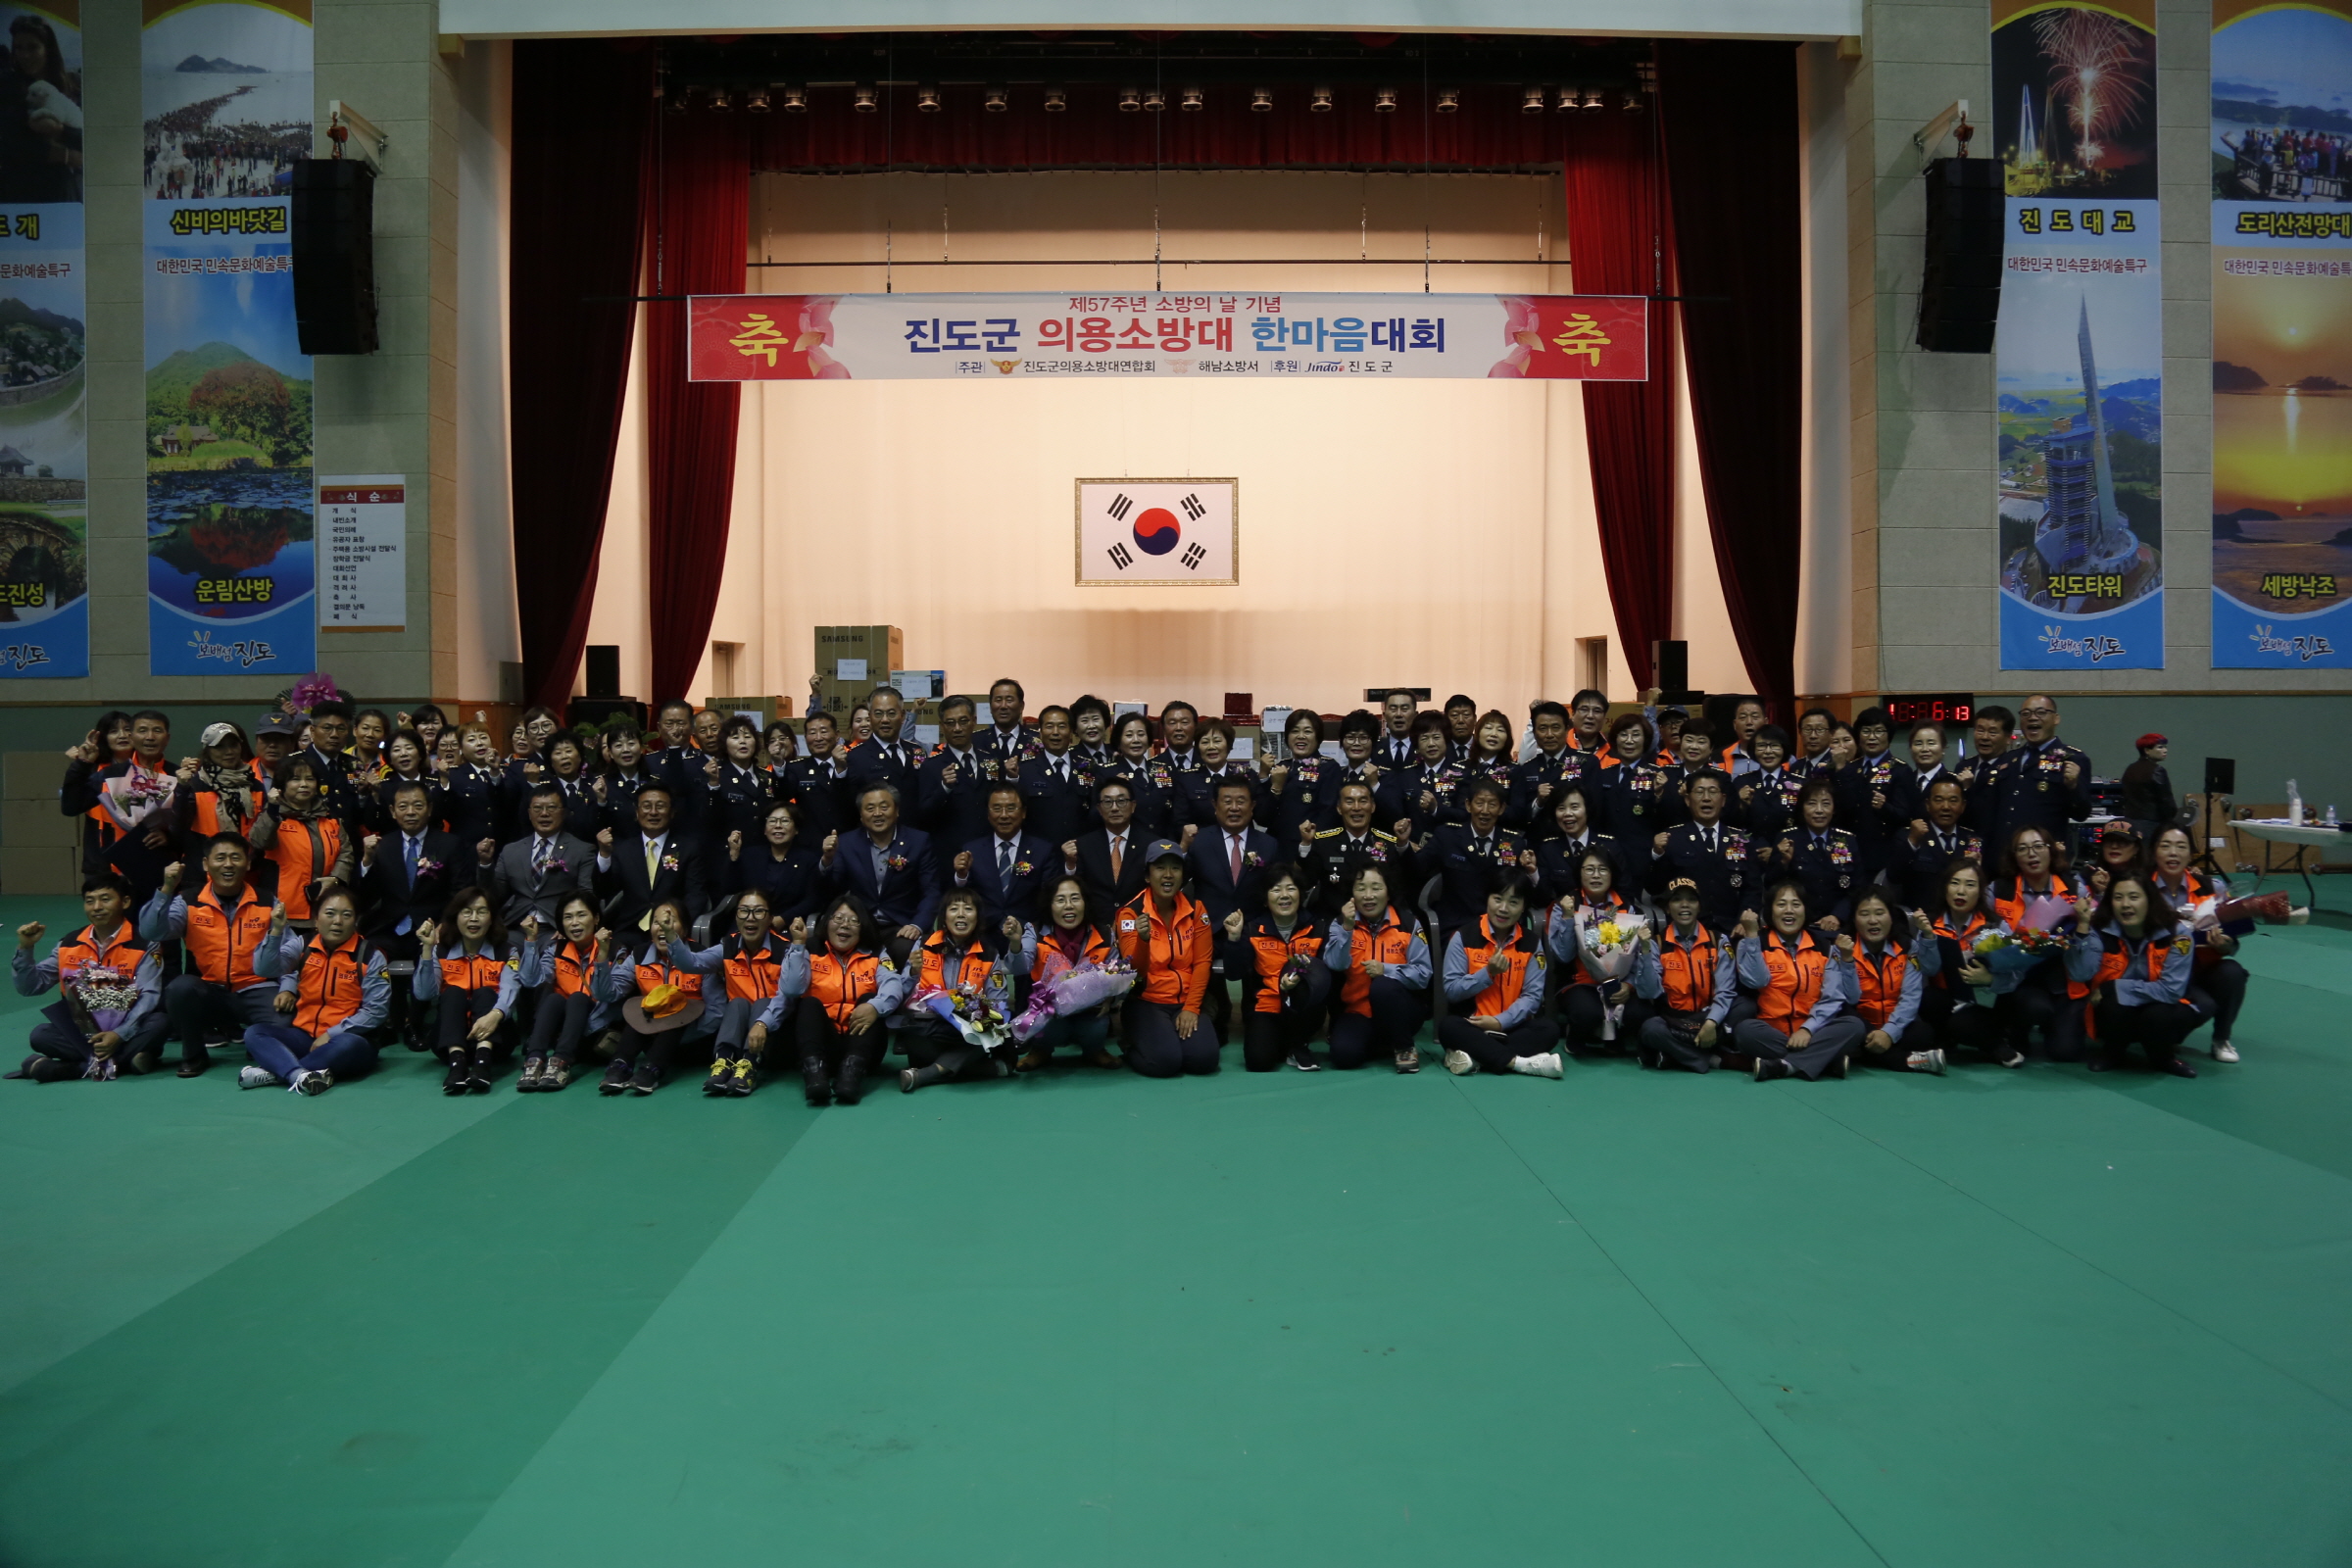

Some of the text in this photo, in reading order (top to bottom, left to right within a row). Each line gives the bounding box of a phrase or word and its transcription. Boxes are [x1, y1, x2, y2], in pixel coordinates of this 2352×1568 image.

[171, 208, 286, 234] 신비의바닷길
[2237, 214, 2351, 236] 도리산전망대
[157, 259, 203, 274] 대한민국
[2008, 257, 2147, 273] 대한민국 민속문화예술특구
[2225, 260, 2269, 275] 대한민국
[1069, 296, 1281, 314] 제57주년 소방의 날 기념
[729, 313, 789, 368] 축
[904, 317, 1445, 353] 진도군 의용소방대 한마음대회
[1552, 313, 1611, 368] 축
[1023, 361, 1155, 373] 진도군의용소방대연합회
[1199, 360, 1259, 372] 해남소방서
[195, 578, 273, 603] 운림산방
[2047, 574, 2122, 598] 진도타워
[2261, 575, 2335, 598] 세방낙조
[8, 644, 50, 670] 진도
[197, 640, 275, 666] 보배섬 진도
[2048, 636, 2126, 662] 보배섬 진도
[2259, 635, 2333, 662] 보배섬 진도
[1668, 877, 1697, 891] CLASSIC
